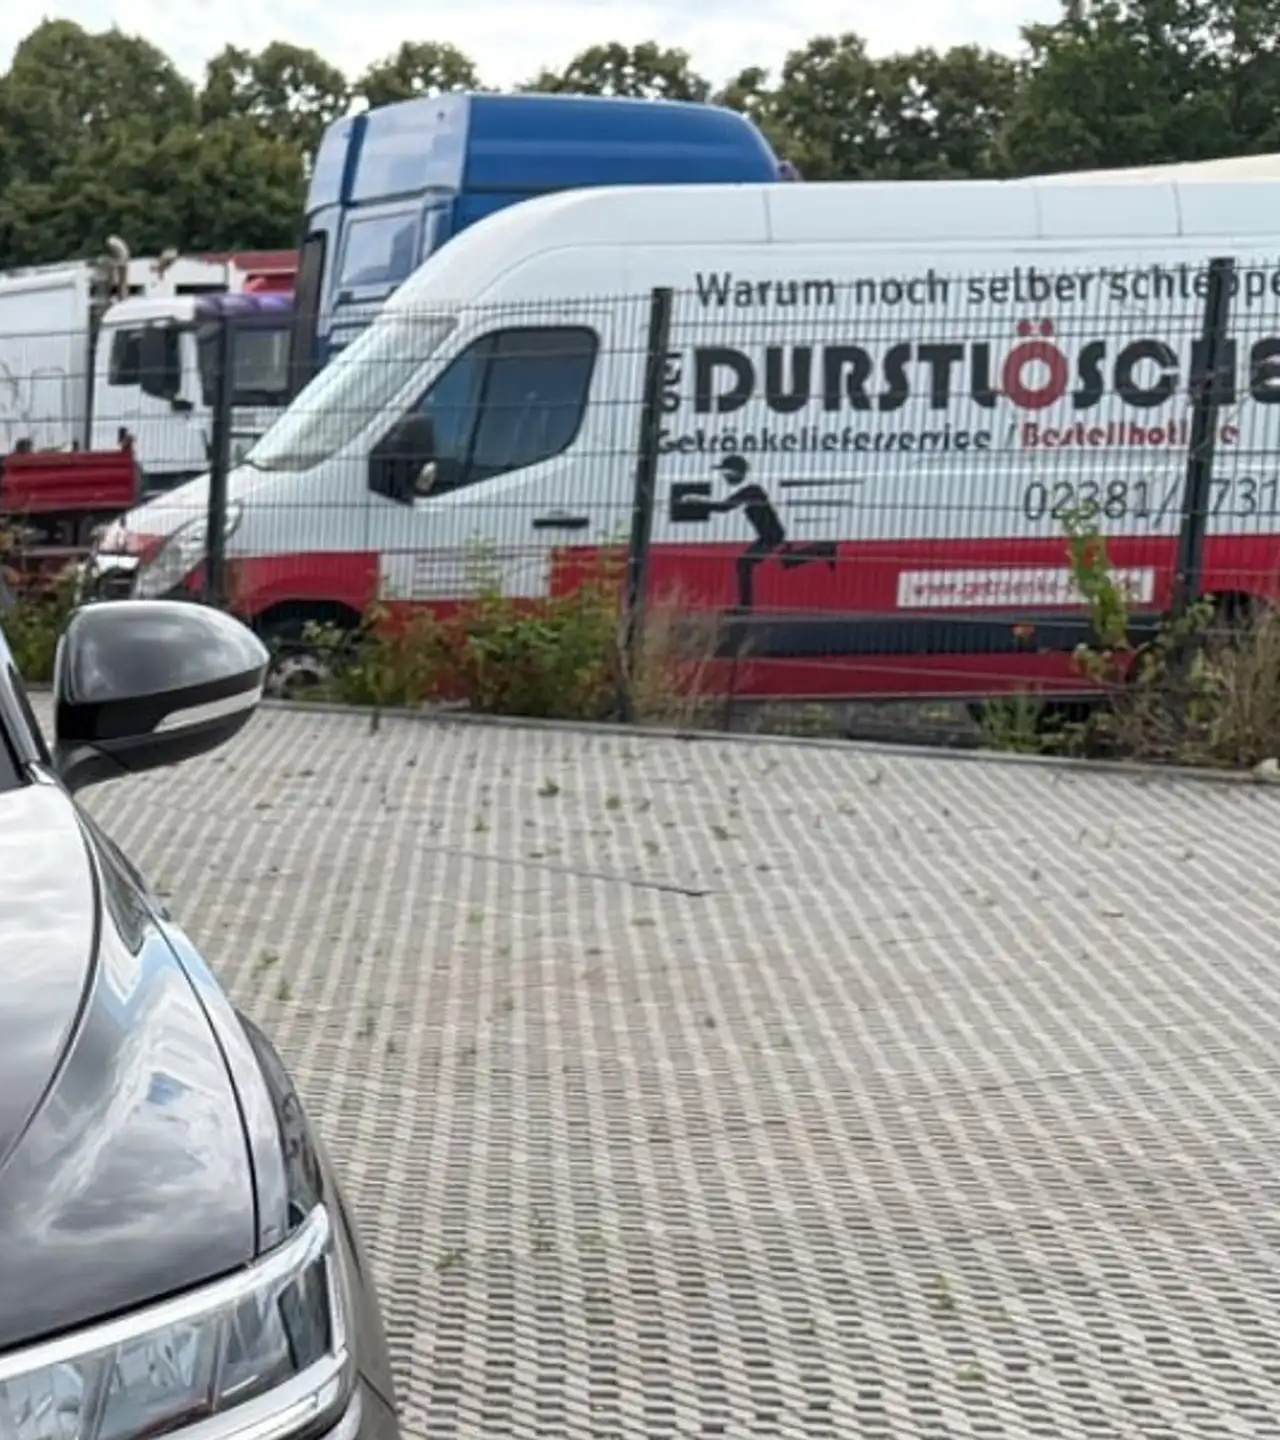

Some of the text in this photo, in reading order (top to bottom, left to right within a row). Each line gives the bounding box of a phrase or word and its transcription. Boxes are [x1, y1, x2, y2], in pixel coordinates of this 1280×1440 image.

[695, 272, 835, 307] Warum
[855, 268, 949, 305] noch
[967, 265, 1091, 303] selber
[1021, 419, 1240, 449] Bestellhotle
